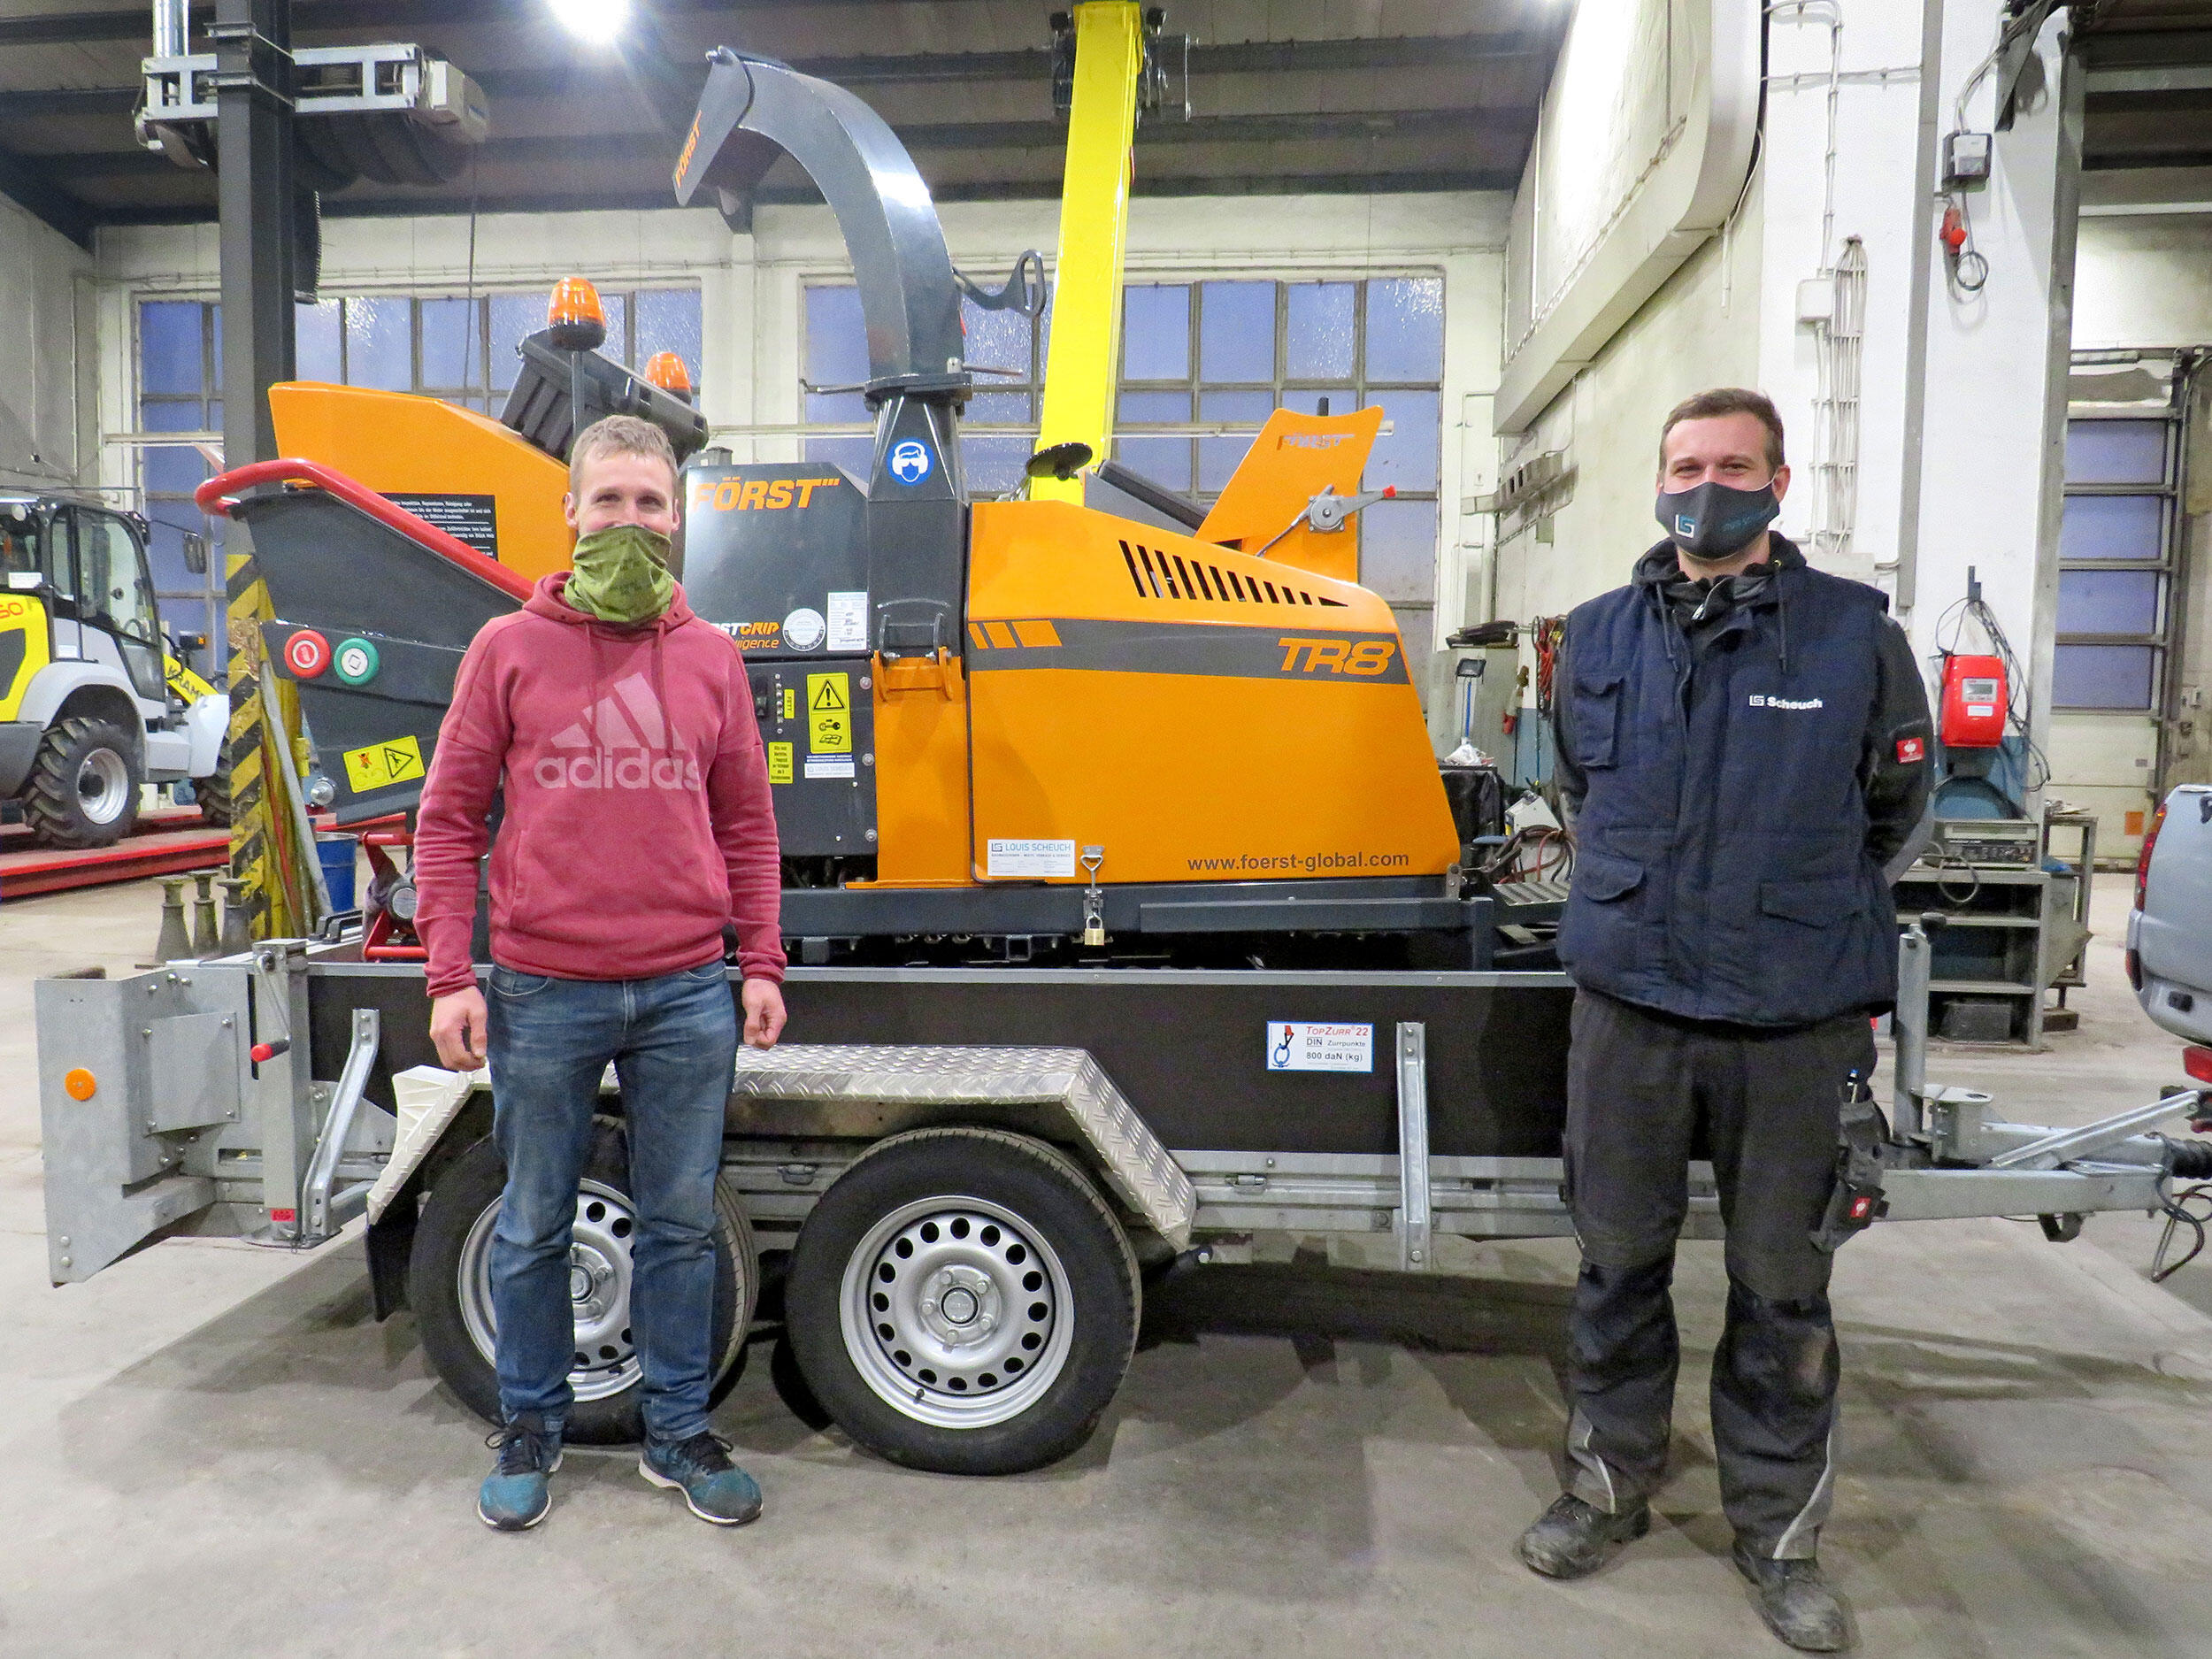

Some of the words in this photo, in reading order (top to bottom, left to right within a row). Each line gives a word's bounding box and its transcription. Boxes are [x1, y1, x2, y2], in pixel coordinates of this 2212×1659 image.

[694, 476, 840, 511] FÖRST
[1278, 638, 1396, 676] TR8
[1766, 696, 1823, 710] Scheuch
[534, 745, 702, 791] adidas
[1005, 842, 1030, 851] LOUIS
[1032, 842, 1071, 851] SCHEUCH
[1187, 851, 1409, 872] www.foerst-global.com
[1356, 1027, 1369, 1036] 22
[1346, 1053, 1363, 1062] (kg)
